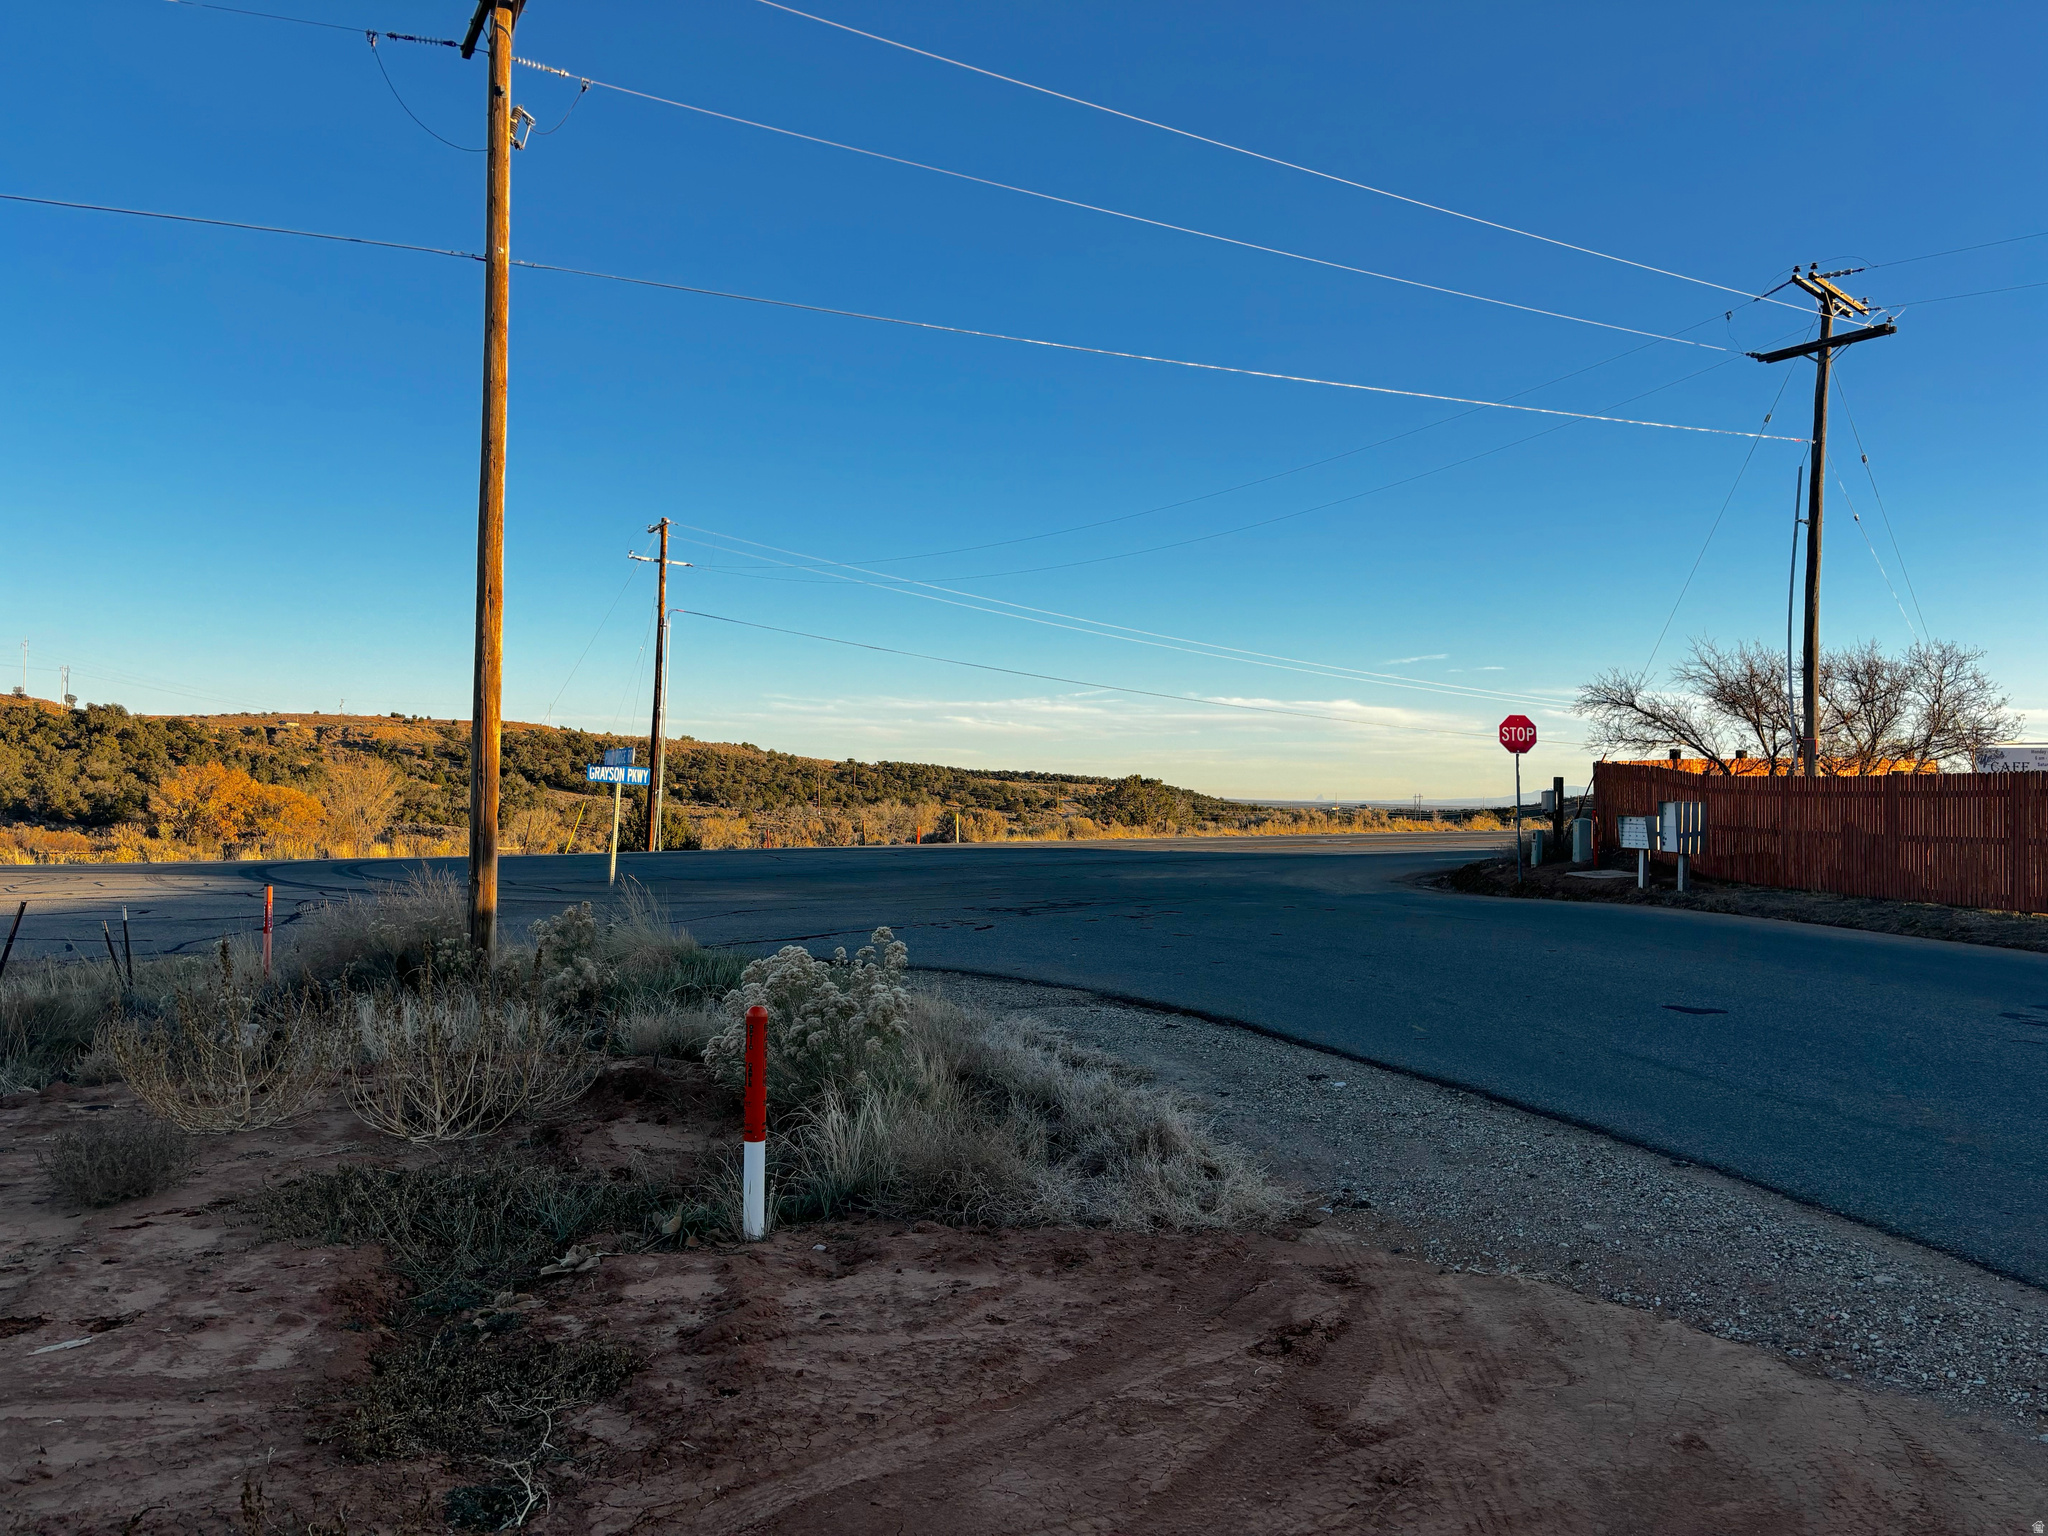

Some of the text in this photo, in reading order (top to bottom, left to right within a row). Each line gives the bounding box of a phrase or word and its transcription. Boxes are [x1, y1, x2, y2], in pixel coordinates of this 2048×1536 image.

[1501, 727, 1535, 742] STOP
[589, 766, 649, 783] GRAYSON PKWY
[1990, 762, 2030, 772] CAFE
